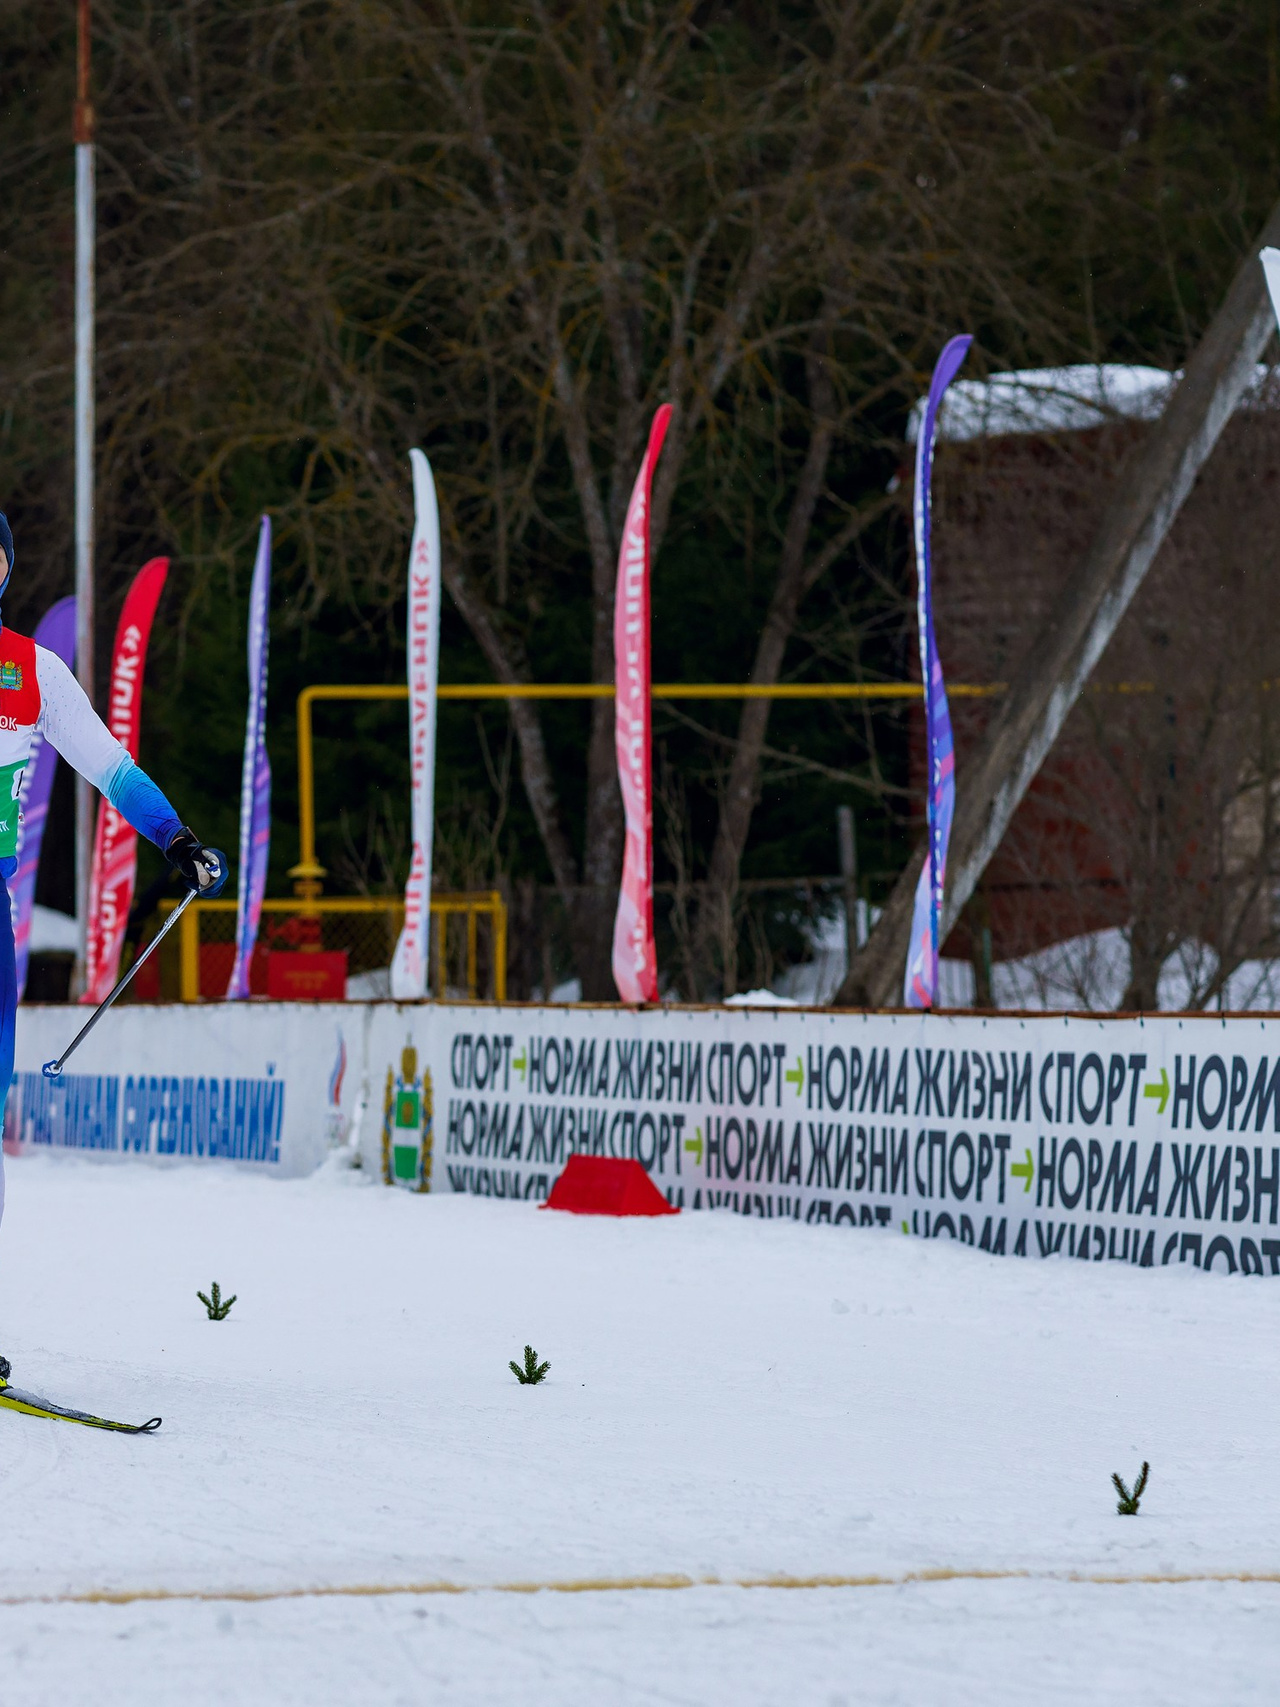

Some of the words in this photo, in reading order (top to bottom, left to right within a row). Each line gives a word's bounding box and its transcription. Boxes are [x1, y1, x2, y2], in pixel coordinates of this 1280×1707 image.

[451, 1033, 514, 1092] СПОРТ
[529, 1035, 611, 1099] НОРМА
[613, 1038, 702, 1103] ЖИЗНИ
[707, 1041, 786, 1107] СПОРТ
[808, 1044, 909, 1115] НОРМА
[914, 1048, 1032, 1122] ЖИЗНИ
[1038, 1051, 1147, 1126] СПОРТ
[446, 1098, 524, 1159] НОРМА
[526, 1104, 607, 1163] ЖИЗНИ
[705, 1115, 802, 1187] НОРМА
[807, 1121, 908, 1196] ЖИЗНИ
[914, 1128, 1011, 1204] СПОРТ
[1035, 1136, 1162, 1217] НОРМА
